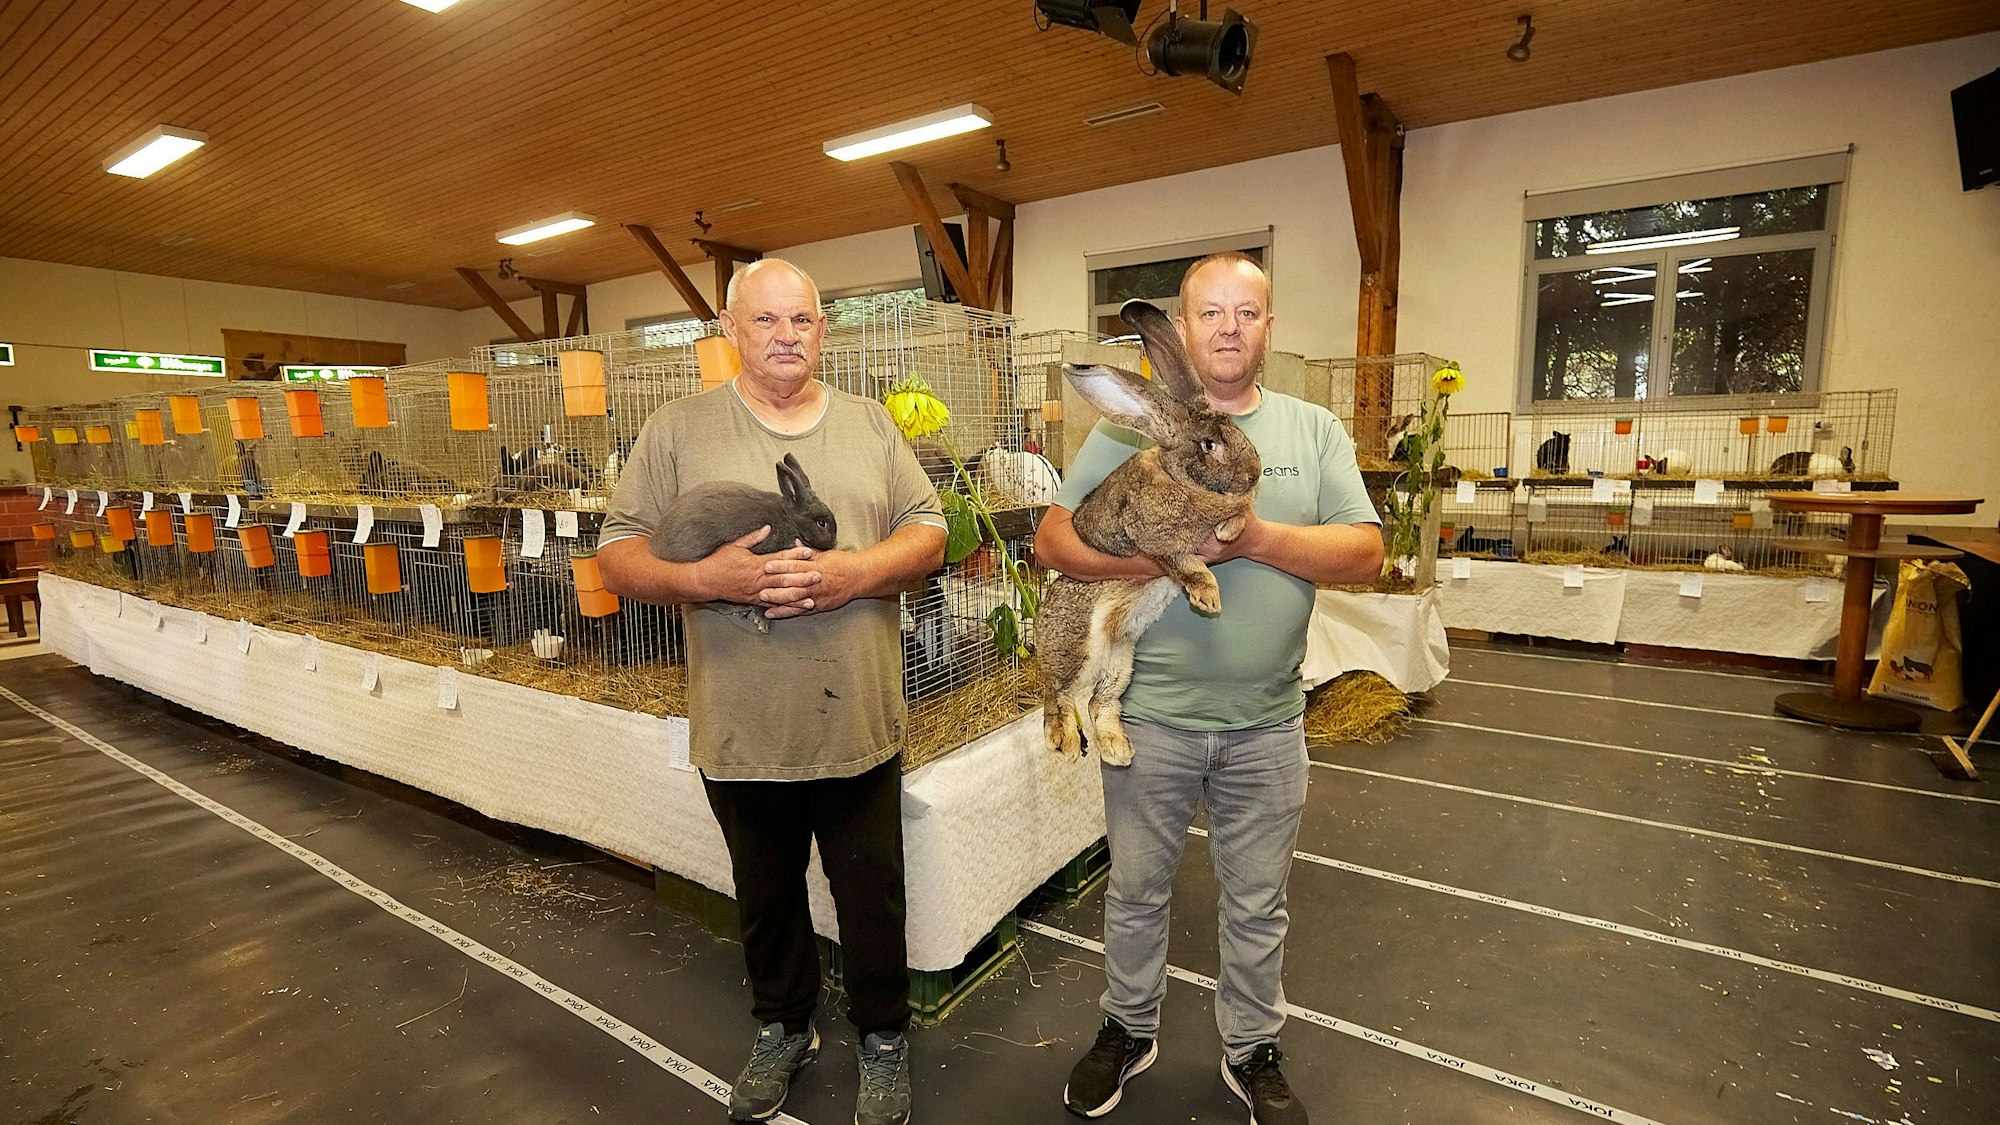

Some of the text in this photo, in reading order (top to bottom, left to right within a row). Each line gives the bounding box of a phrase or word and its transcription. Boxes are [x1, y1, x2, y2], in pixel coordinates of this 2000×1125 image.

[1263, 466, 1300, 477] eans
[1059, 933, 1087, 945] JOKA
[1840, 977, 1882, 992] JOKA
[1915, 996, 1960, 1011] JOKA
[596, 1015, 622, 1031] JOKA
[1304, 1012, 1338, 1027] JOKA
[630, 1034, 657, 1051] JOKA
[1363, 1031, 1400, 1047] JOKA
[665, 1056, 693, 1074] JOKA
[1426, 1051, 1466, 1069] JOKA
[1494, 1073, 1537, 1092] JOKA
[1568, 1097, 1614, 1117] JOKA
